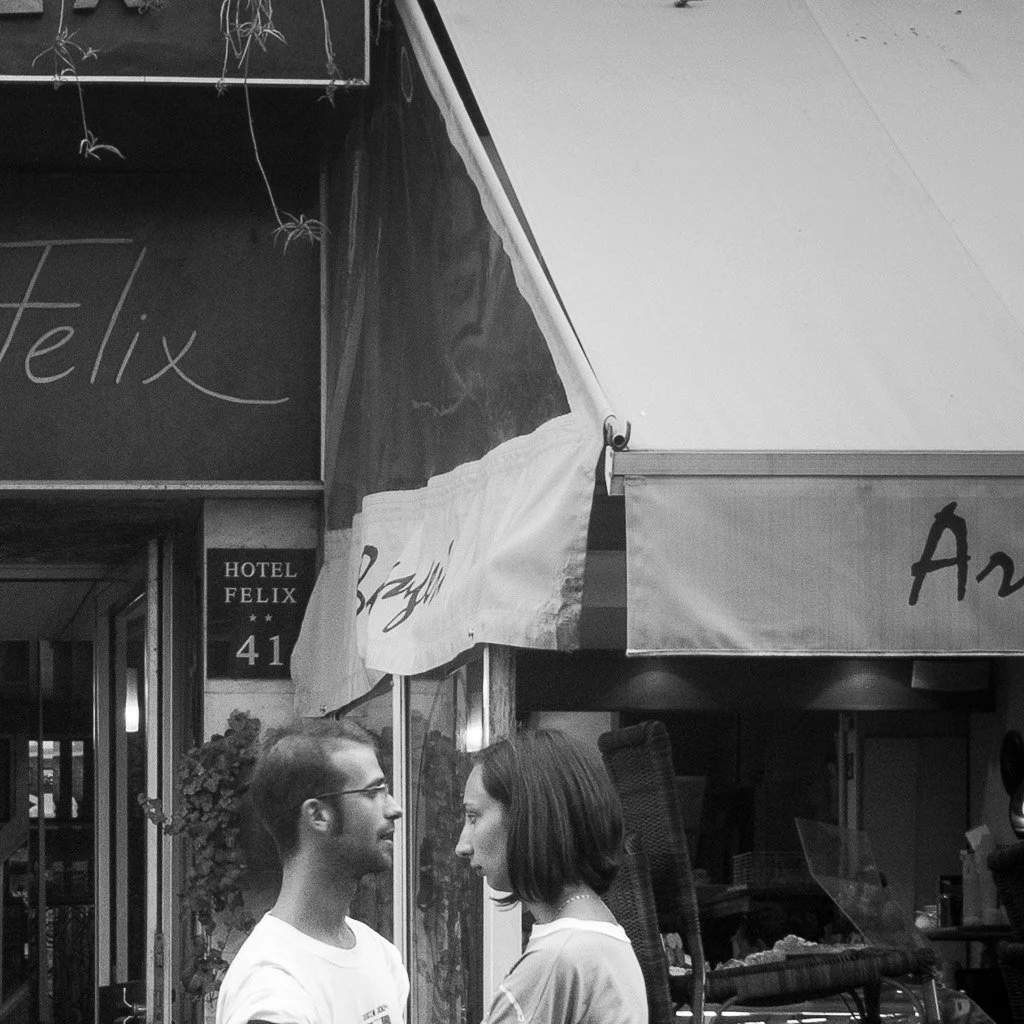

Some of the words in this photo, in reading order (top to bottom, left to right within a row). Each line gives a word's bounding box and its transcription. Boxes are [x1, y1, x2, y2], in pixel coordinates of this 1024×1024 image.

[223, 561, 298, 578] HOTEL
[223, 586, 298, 604] FELIX
[235, 634, 284, 666] 41
